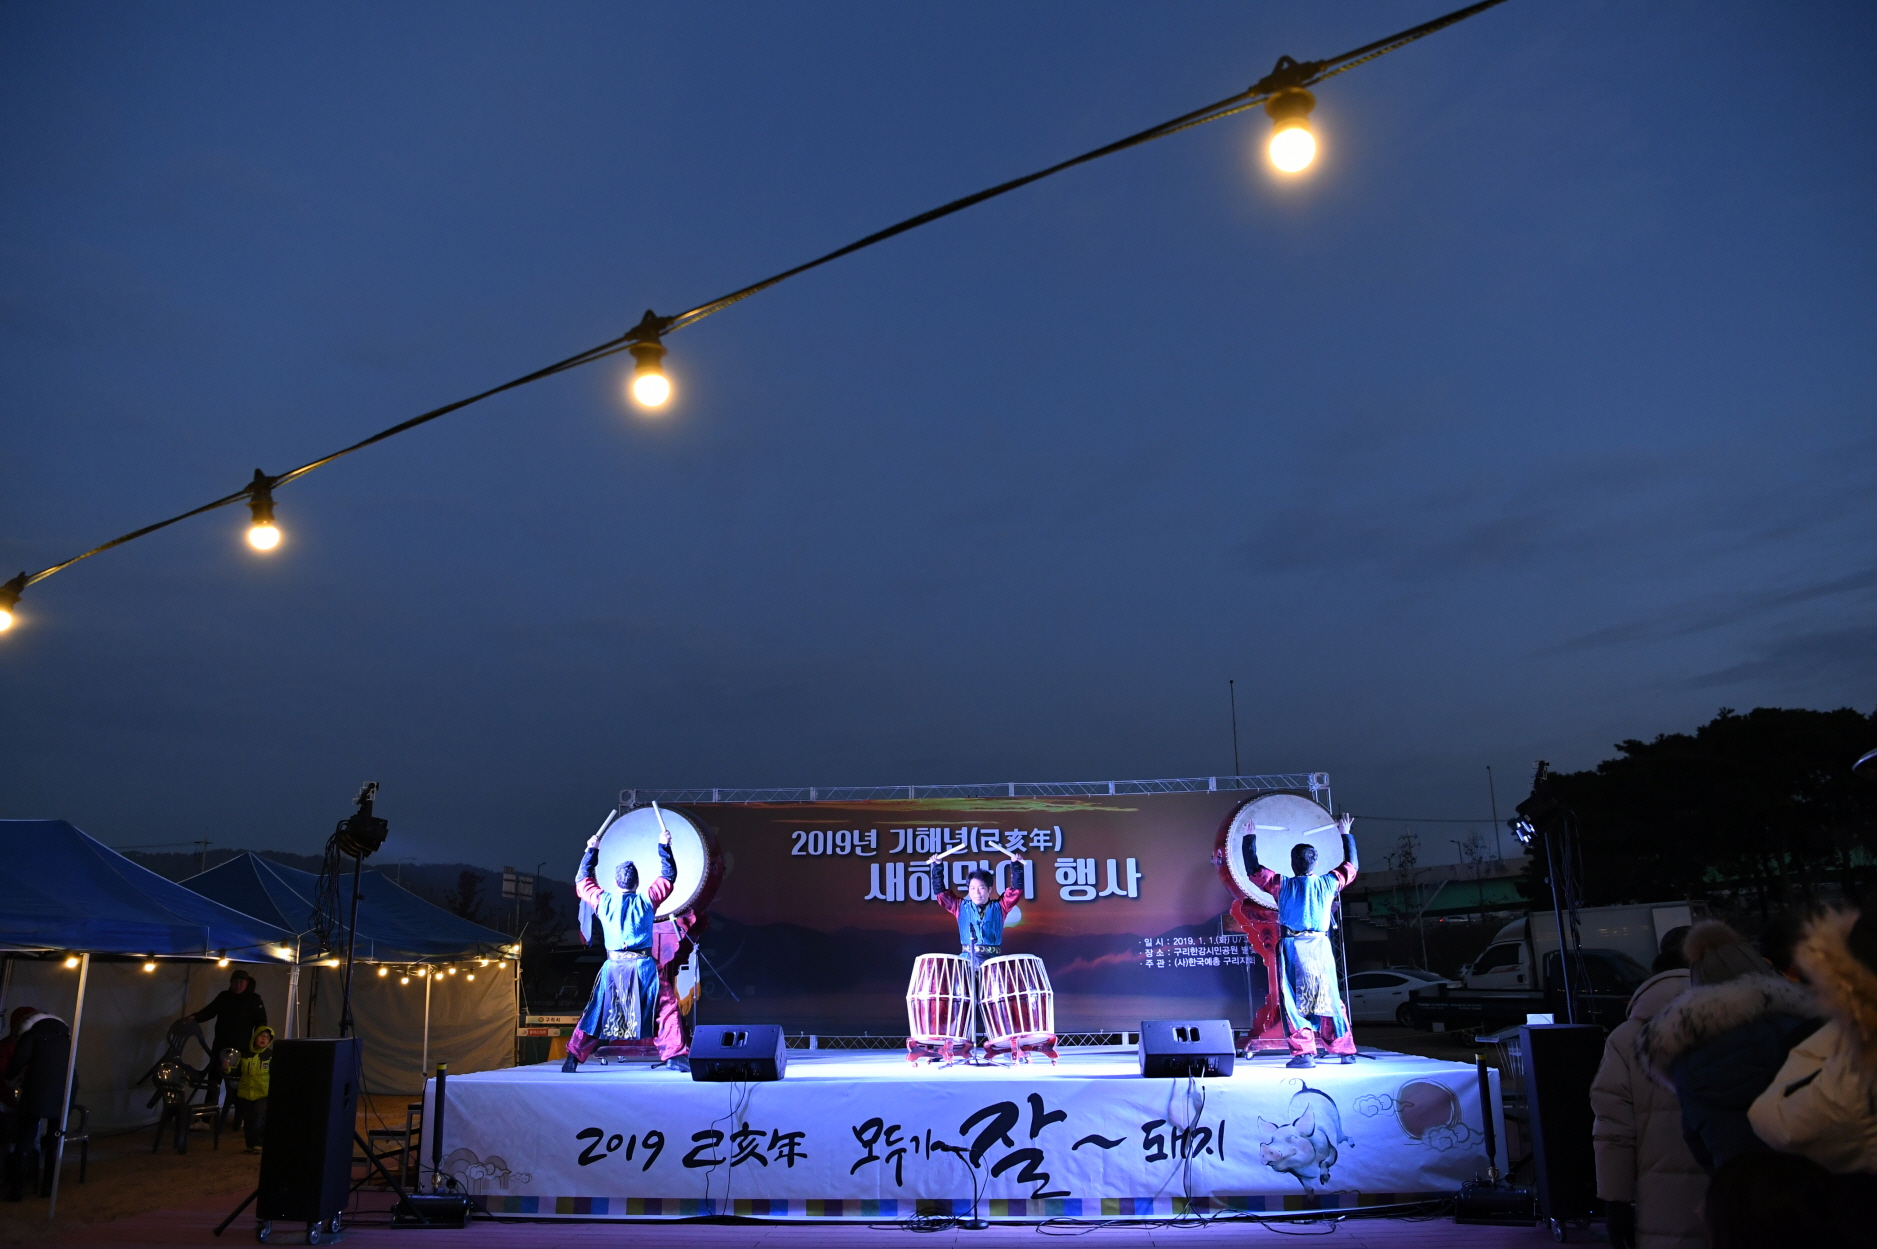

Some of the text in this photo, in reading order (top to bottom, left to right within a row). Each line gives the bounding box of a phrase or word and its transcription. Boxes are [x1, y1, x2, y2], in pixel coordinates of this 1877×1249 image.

[791, 828, 877, 856] 2019년
[1054, 857, 1142, 901] 행사
[1173, 945, 1239, 956] 구리한강시민공원
[575, 1126, 665, 1172] 2019
